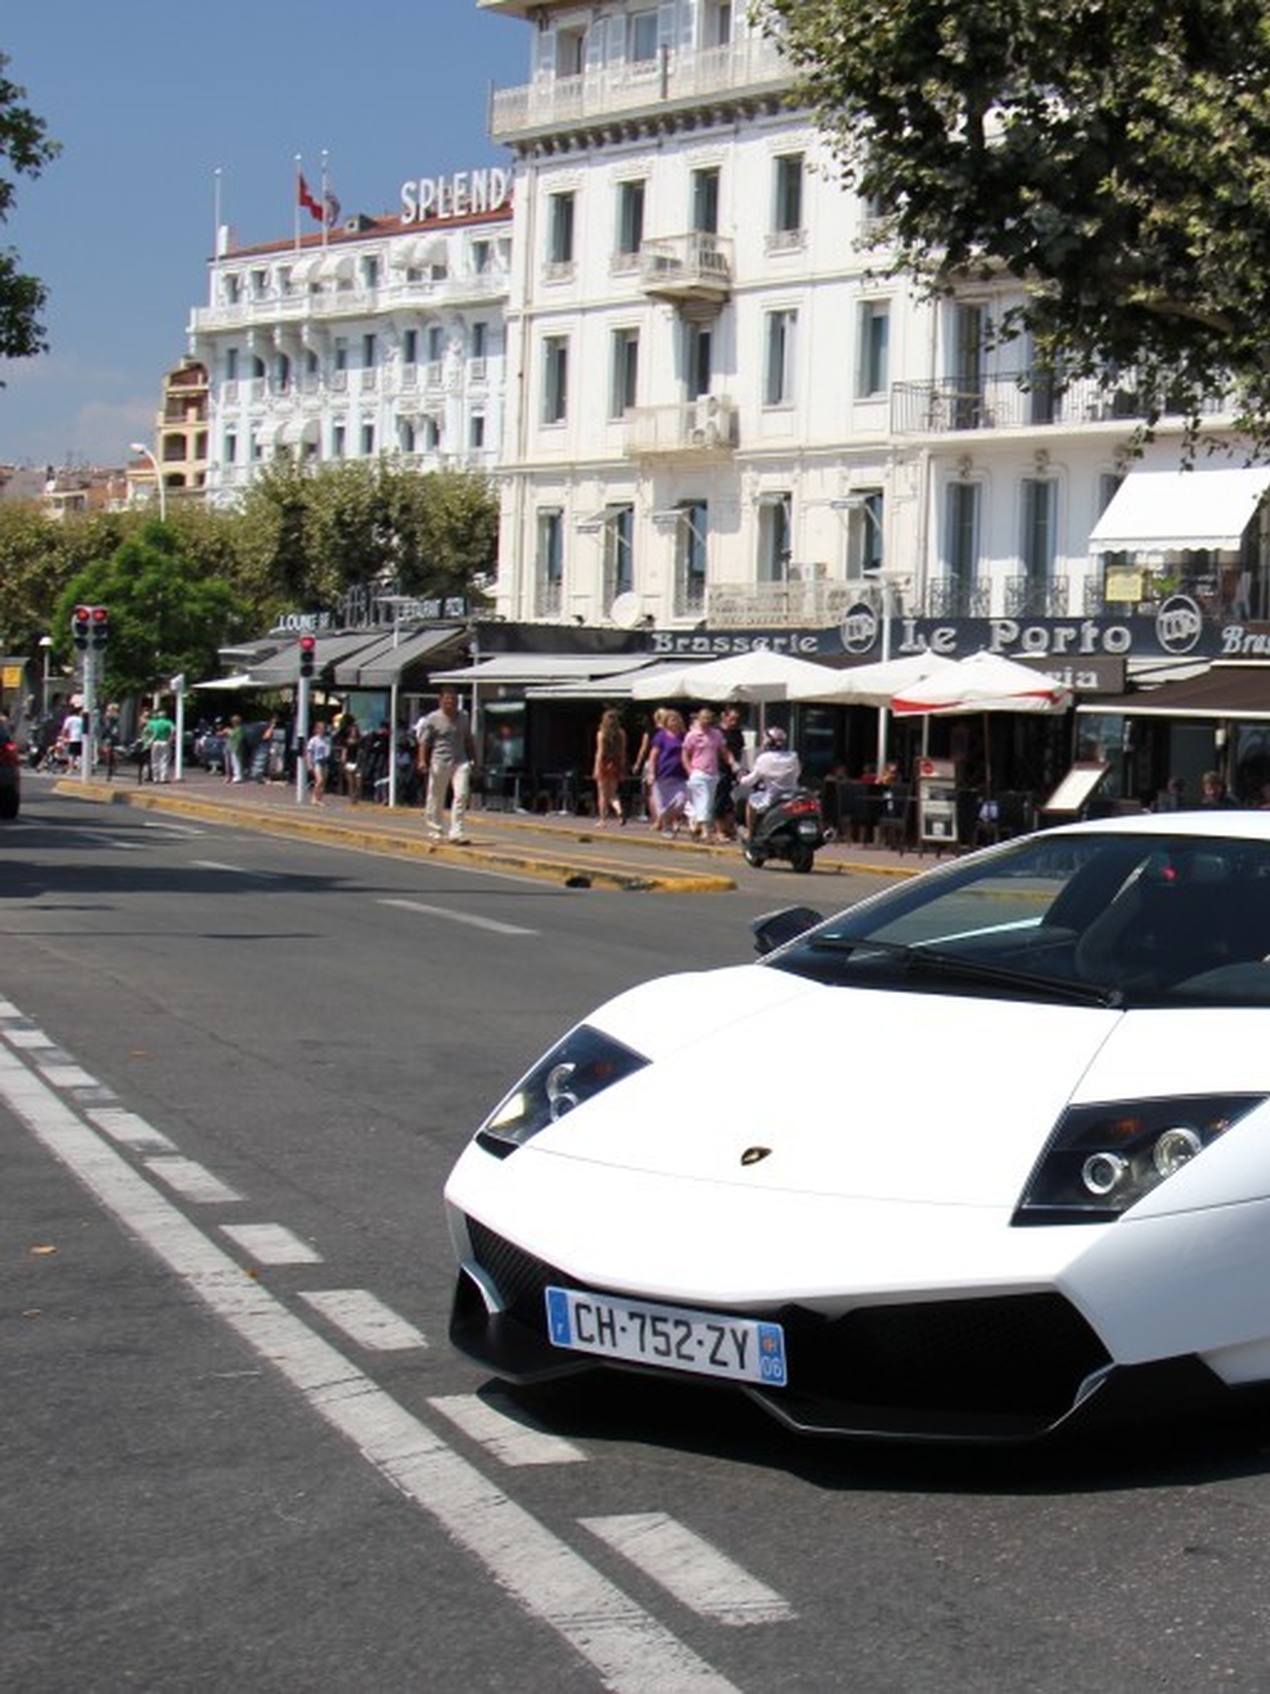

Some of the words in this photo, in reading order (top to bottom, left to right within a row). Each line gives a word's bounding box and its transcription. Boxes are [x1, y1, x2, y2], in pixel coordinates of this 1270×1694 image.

[652, 633, 819, 653] Brasserie
[899, 620, 957, 653] Le
[990, 620, 1132, 654] Porto
[574, 1302, 749, 1370] CH-752-ZY
[762, 1354, 783, 1379] 06
